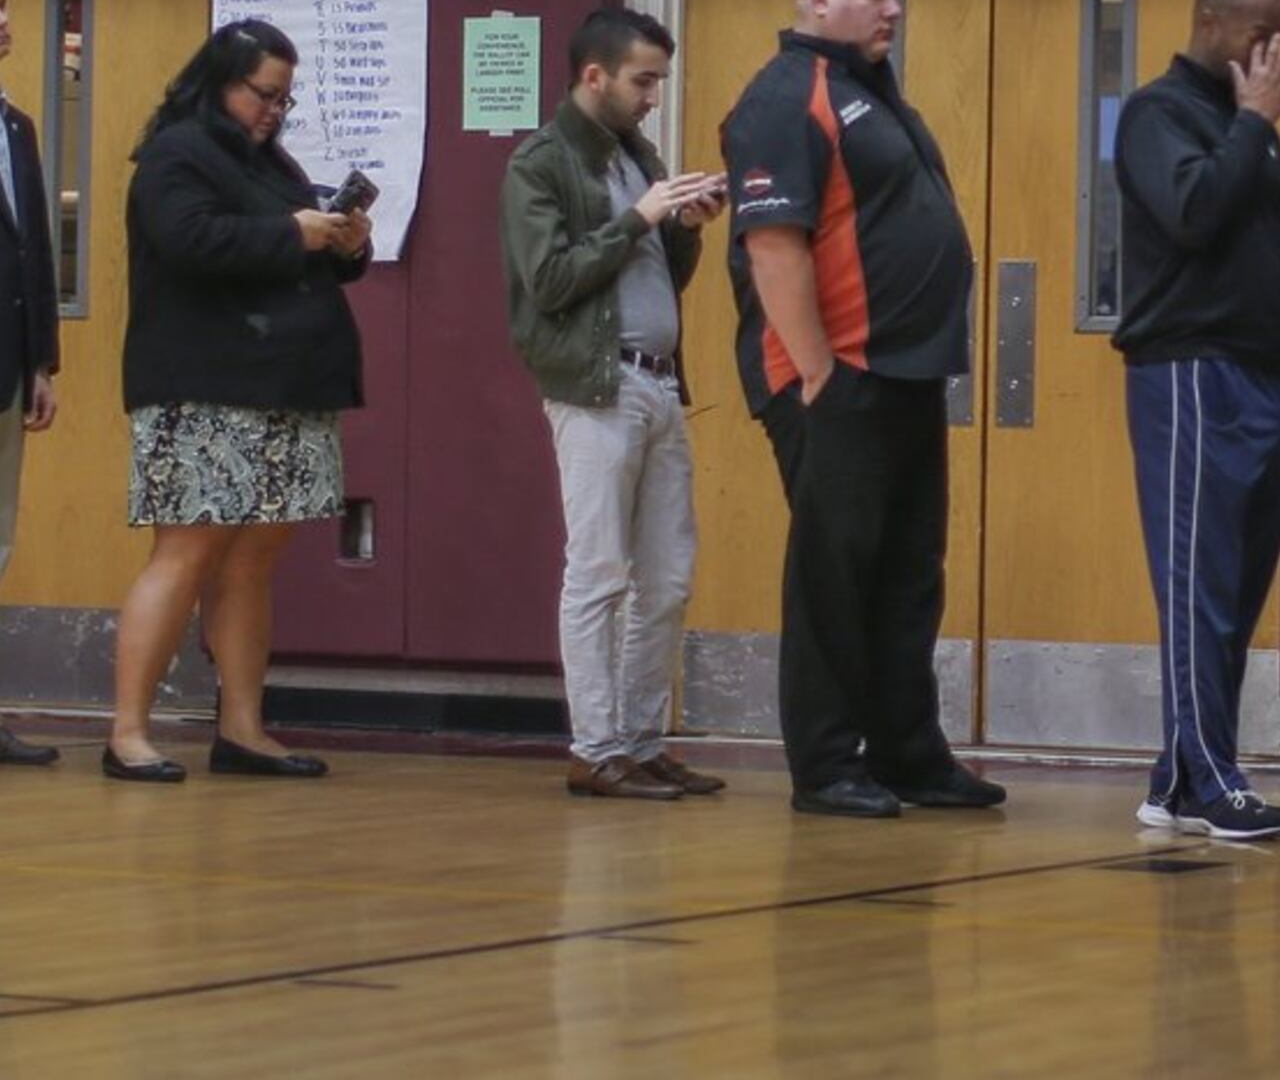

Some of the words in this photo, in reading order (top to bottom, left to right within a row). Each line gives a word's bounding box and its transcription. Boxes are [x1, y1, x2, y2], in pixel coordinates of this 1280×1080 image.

[318, 38, 330, 53] T
[487, 50, 514, 59] BALLOT
[315, 55, 324, 70] U
[315, 70, 327, 86] V
[470, 86, 496, 94] PLEASE
[498, 86, 512, 94] SEE
[513, 86, 532, 94] POLL
[477, 95, 508, 103] OFFICIAL
[509, 94, 525, 103] FOR
[323, 147, 335, 162] Z
